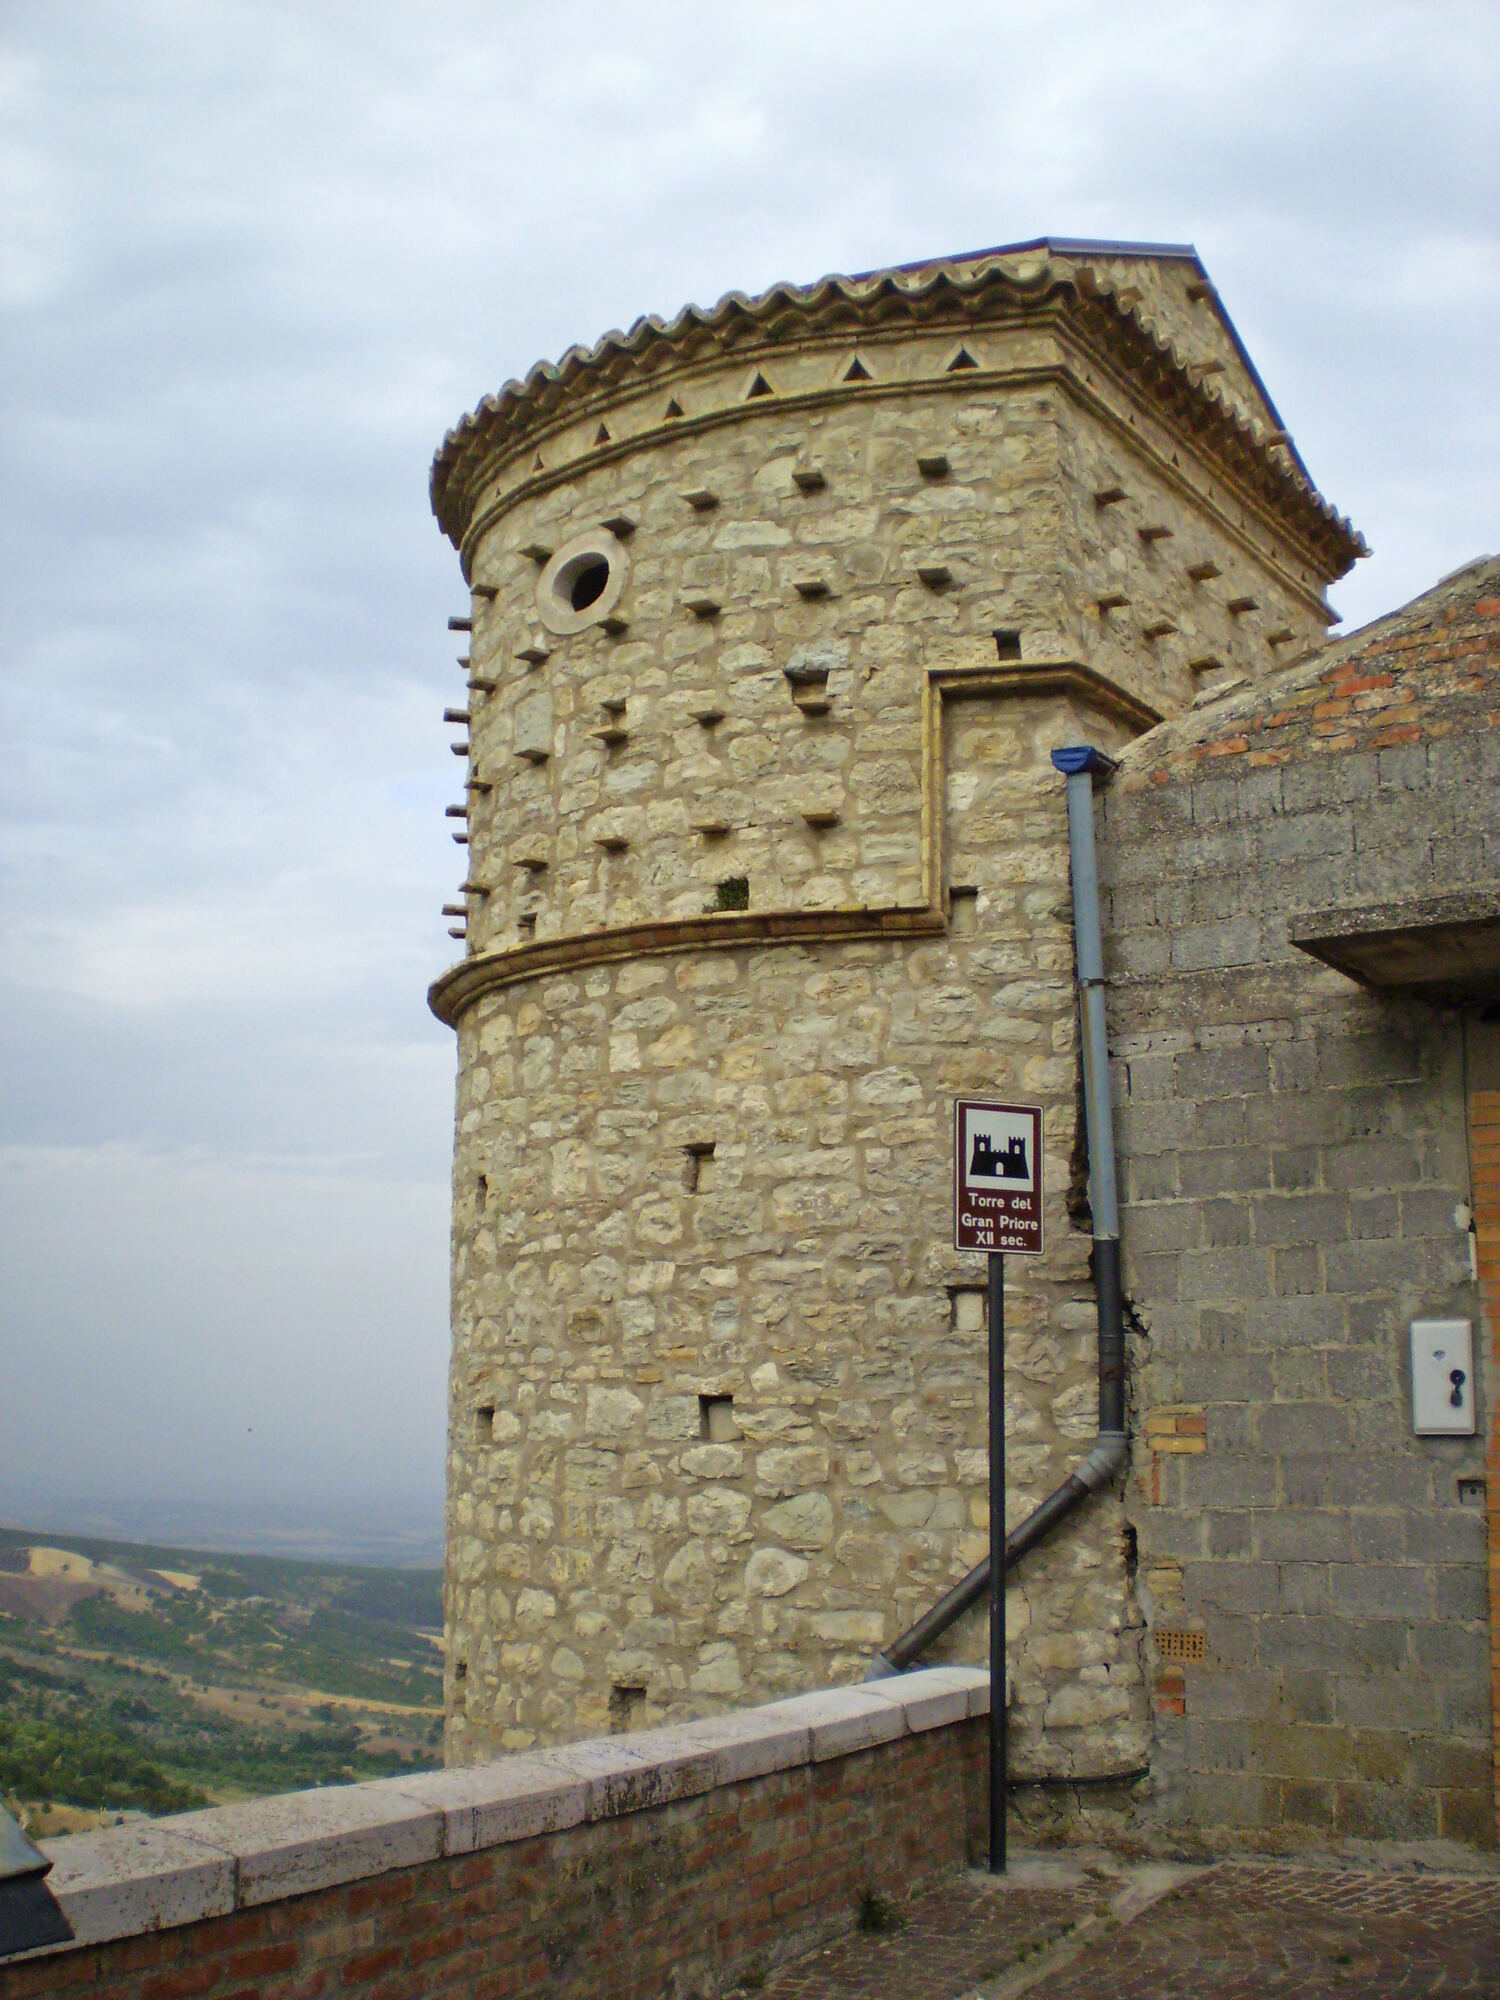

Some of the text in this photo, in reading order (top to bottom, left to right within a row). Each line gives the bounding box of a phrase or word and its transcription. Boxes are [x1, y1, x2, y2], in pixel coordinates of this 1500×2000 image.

[968, 1193, 1032, 1210] Torre del
[961, 1213, 1038, 1230] Gran Priore
[976, 1231, 1027, 1246] XII sec.
